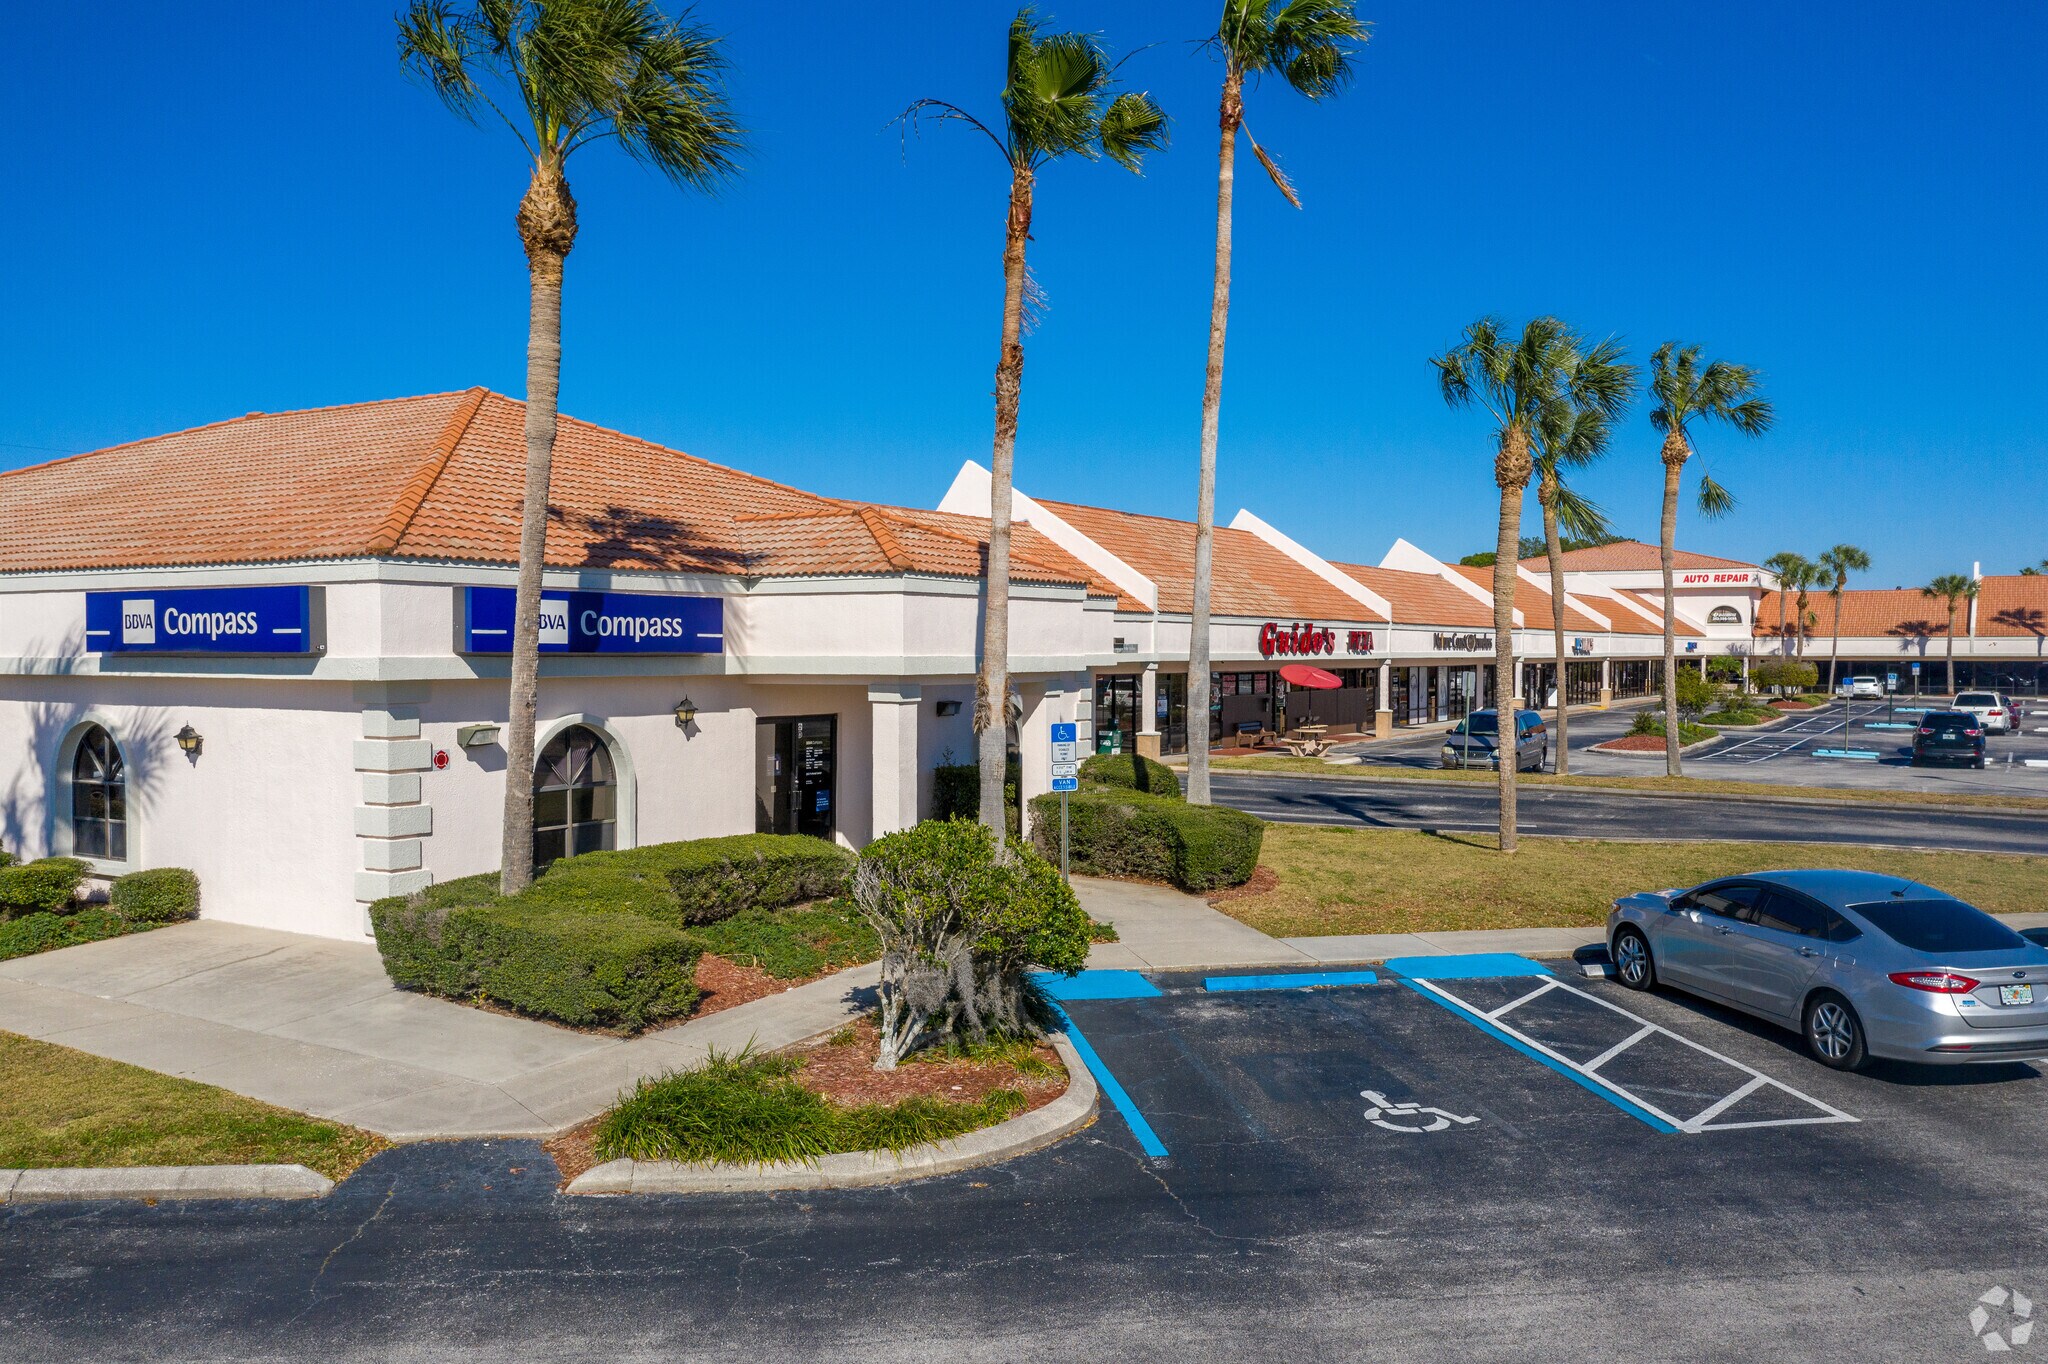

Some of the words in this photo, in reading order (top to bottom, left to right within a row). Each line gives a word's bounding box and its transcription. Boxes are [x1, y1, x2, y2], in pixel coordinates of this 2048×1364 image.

[1683, 574, 1709, 583] AUTO
[1713, 574, 1749, 582] REPAIR
[124, 613, 153, 630] BBVA
[164, 607, 258, 641] Compass
[539, 613, 566, 630] BVA
[580, 610, 683, 642] Compass
[1258, 622, 1336, 656] Guido's
